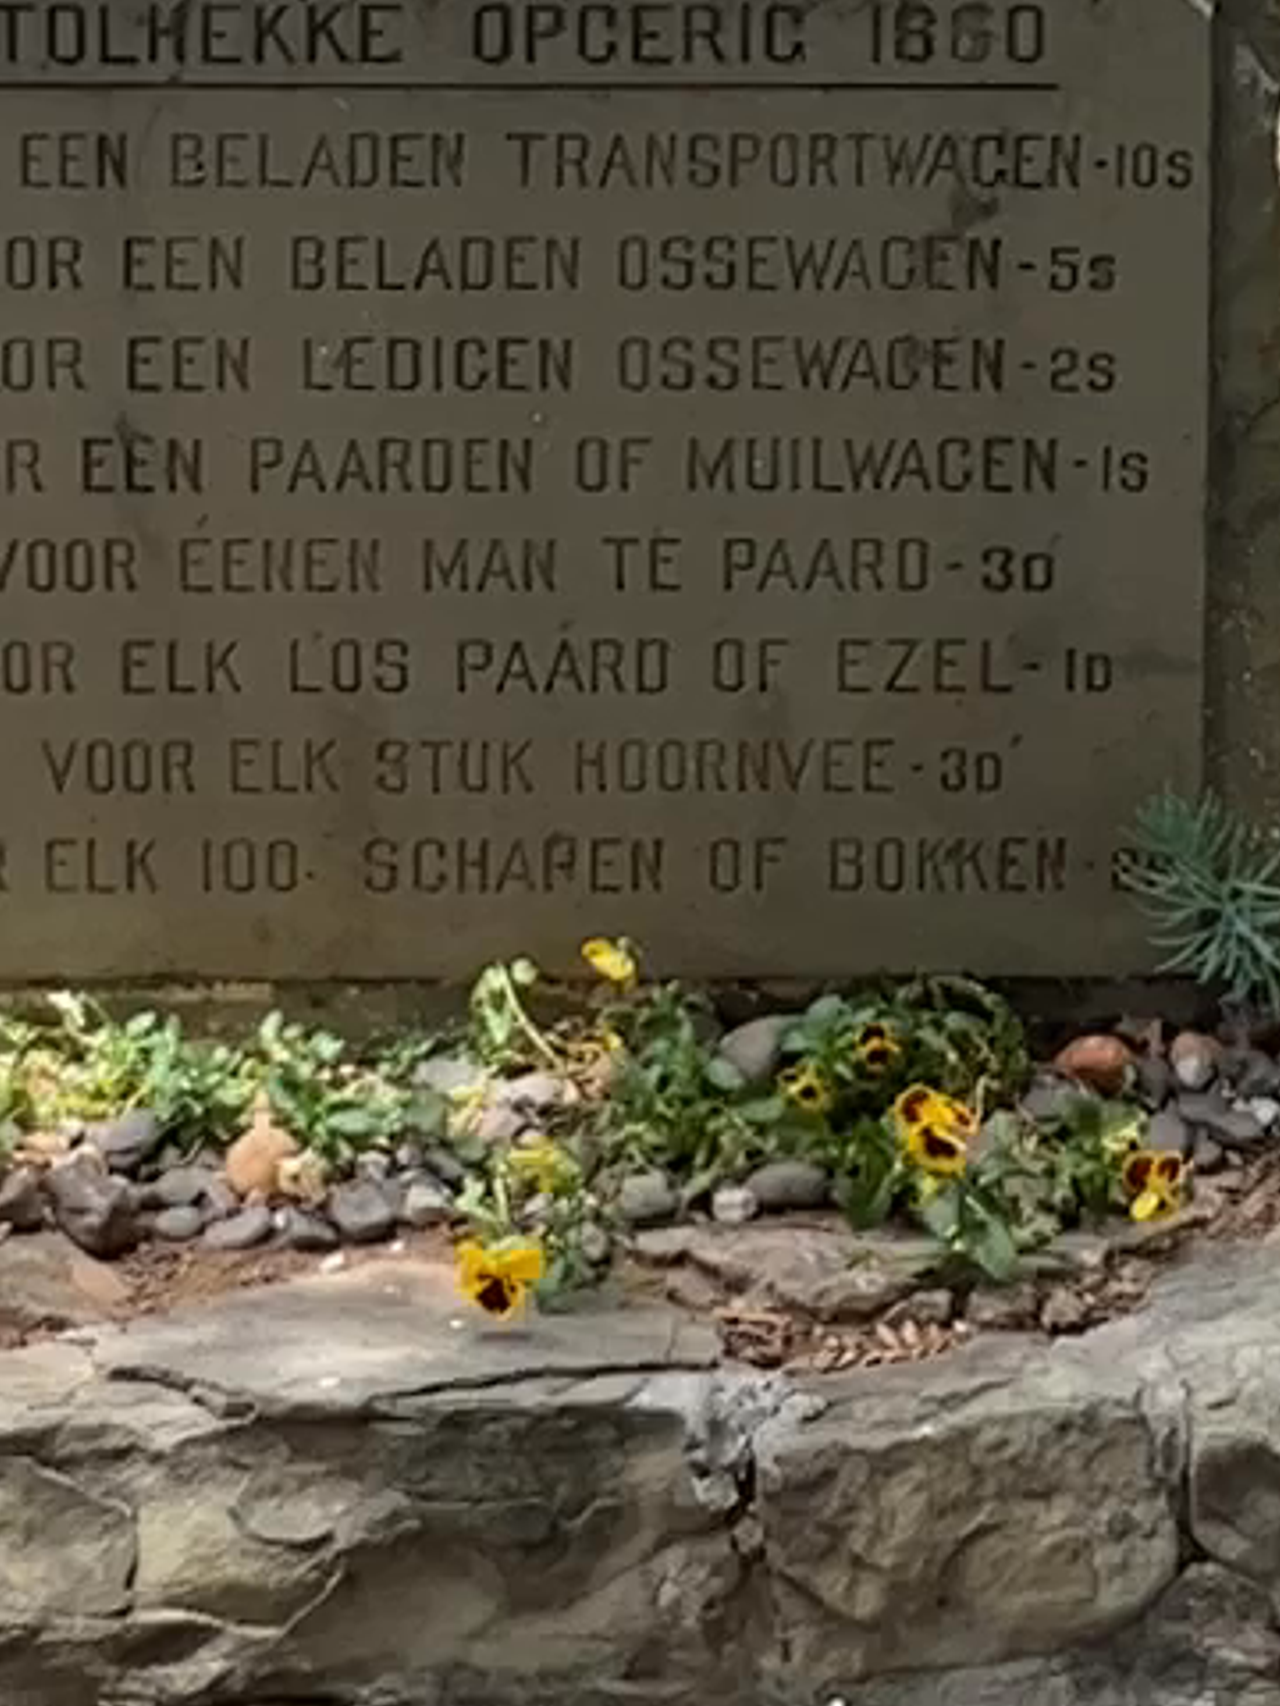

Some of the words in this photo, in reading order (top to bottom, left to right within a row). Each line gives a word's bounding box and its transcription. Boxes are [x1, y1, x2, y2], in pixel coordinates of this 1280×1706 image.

[20, 133, 128, 188] EEN
[169, 132, 466, 188] BELADEN
[123, 235, 245, 291] EEN
[290, 235, 580, 291] BELADEN
[126, 336, 251, 392] EEN
[81, 438, 203, 494] EEN
[249, 437, 532, 494] PAARDEN
[575, 437, 654, 493] OF
[422, 537, 557, 594] MAN
[602, 537, 683, 593] TE
[121, 639, 243, 695] ELK
[289, 638, 411, 695] LOS
[455, 638, 671, 695] PAARD
[710, 638, 789, 695] OF
[41, 739, 196, 794] VOOR
[229, 739, 340, 794] ELK
[374, 738, 532, 794] STUK
[44, 838, 157, 894] ELK
[362, 837, 664, 894] SCHAPEN
[709, 837, 788, 894] OF
